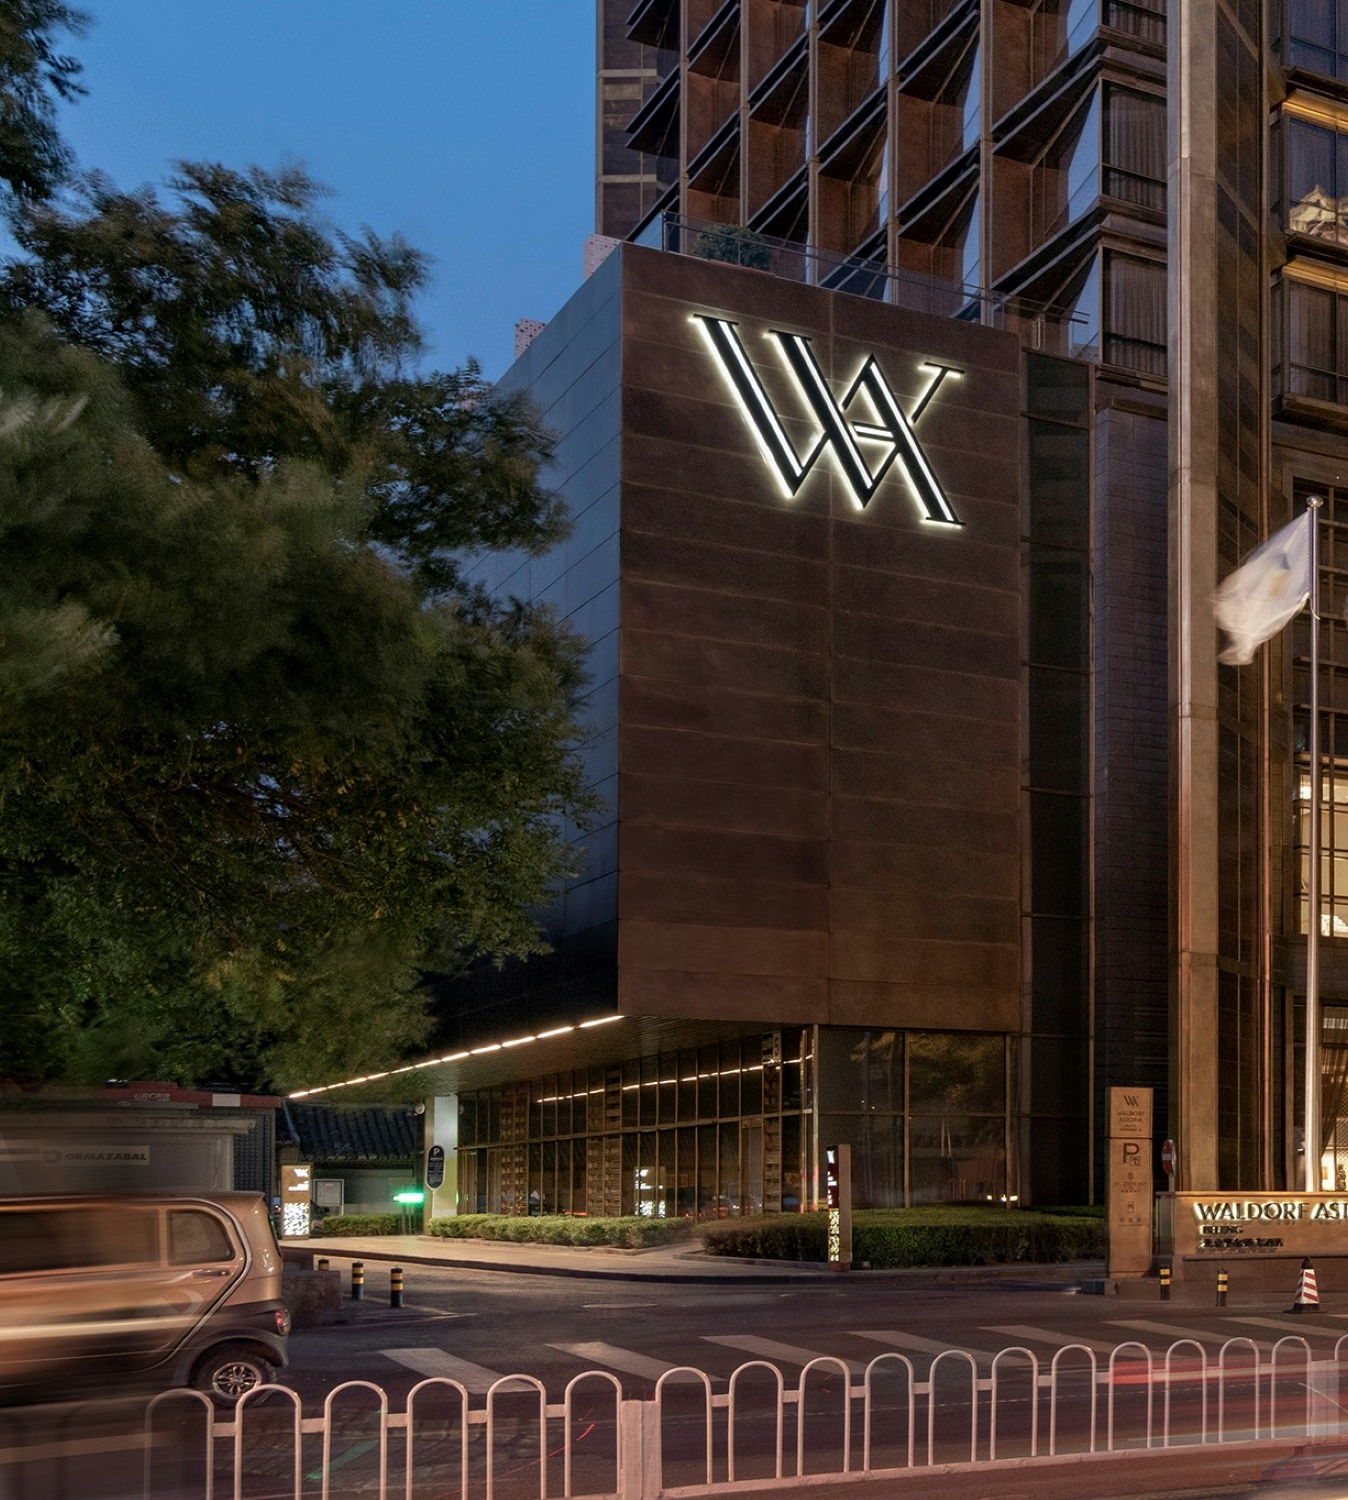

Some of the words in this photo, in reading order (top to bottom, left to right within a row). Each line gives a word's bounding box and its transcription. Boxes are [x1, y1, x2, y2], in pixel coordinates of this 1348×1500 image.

[65, 1152, 147, 1161] ORMAZABAL
[1123, 1142, 1140, 1164] P
[1194, 1201, 1310, 1221] WALDORF
